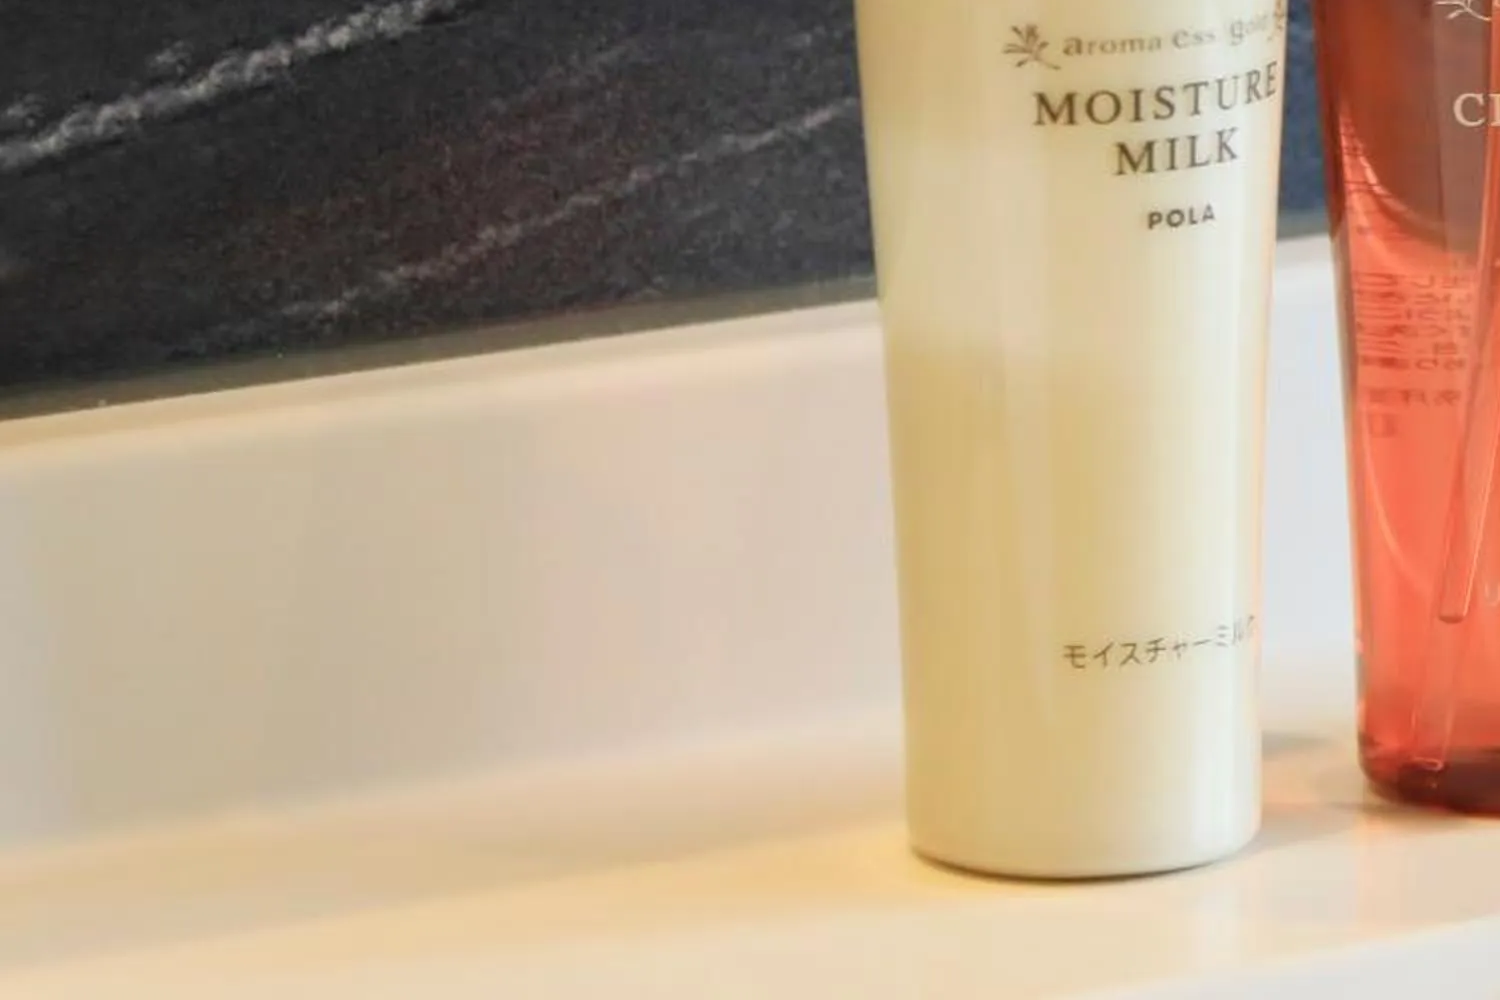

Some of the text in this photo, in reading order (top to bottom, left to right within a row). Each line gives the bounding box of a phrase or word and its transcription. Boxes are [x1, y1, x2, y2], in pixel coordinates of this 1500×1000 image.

[1062, 34, 1163, 57] aroma
[1033, 60, 1279, 127] MOISTURE
[1114, 126, 1240, 176] MILK
[1146, 203, 1216, 230] POLA
